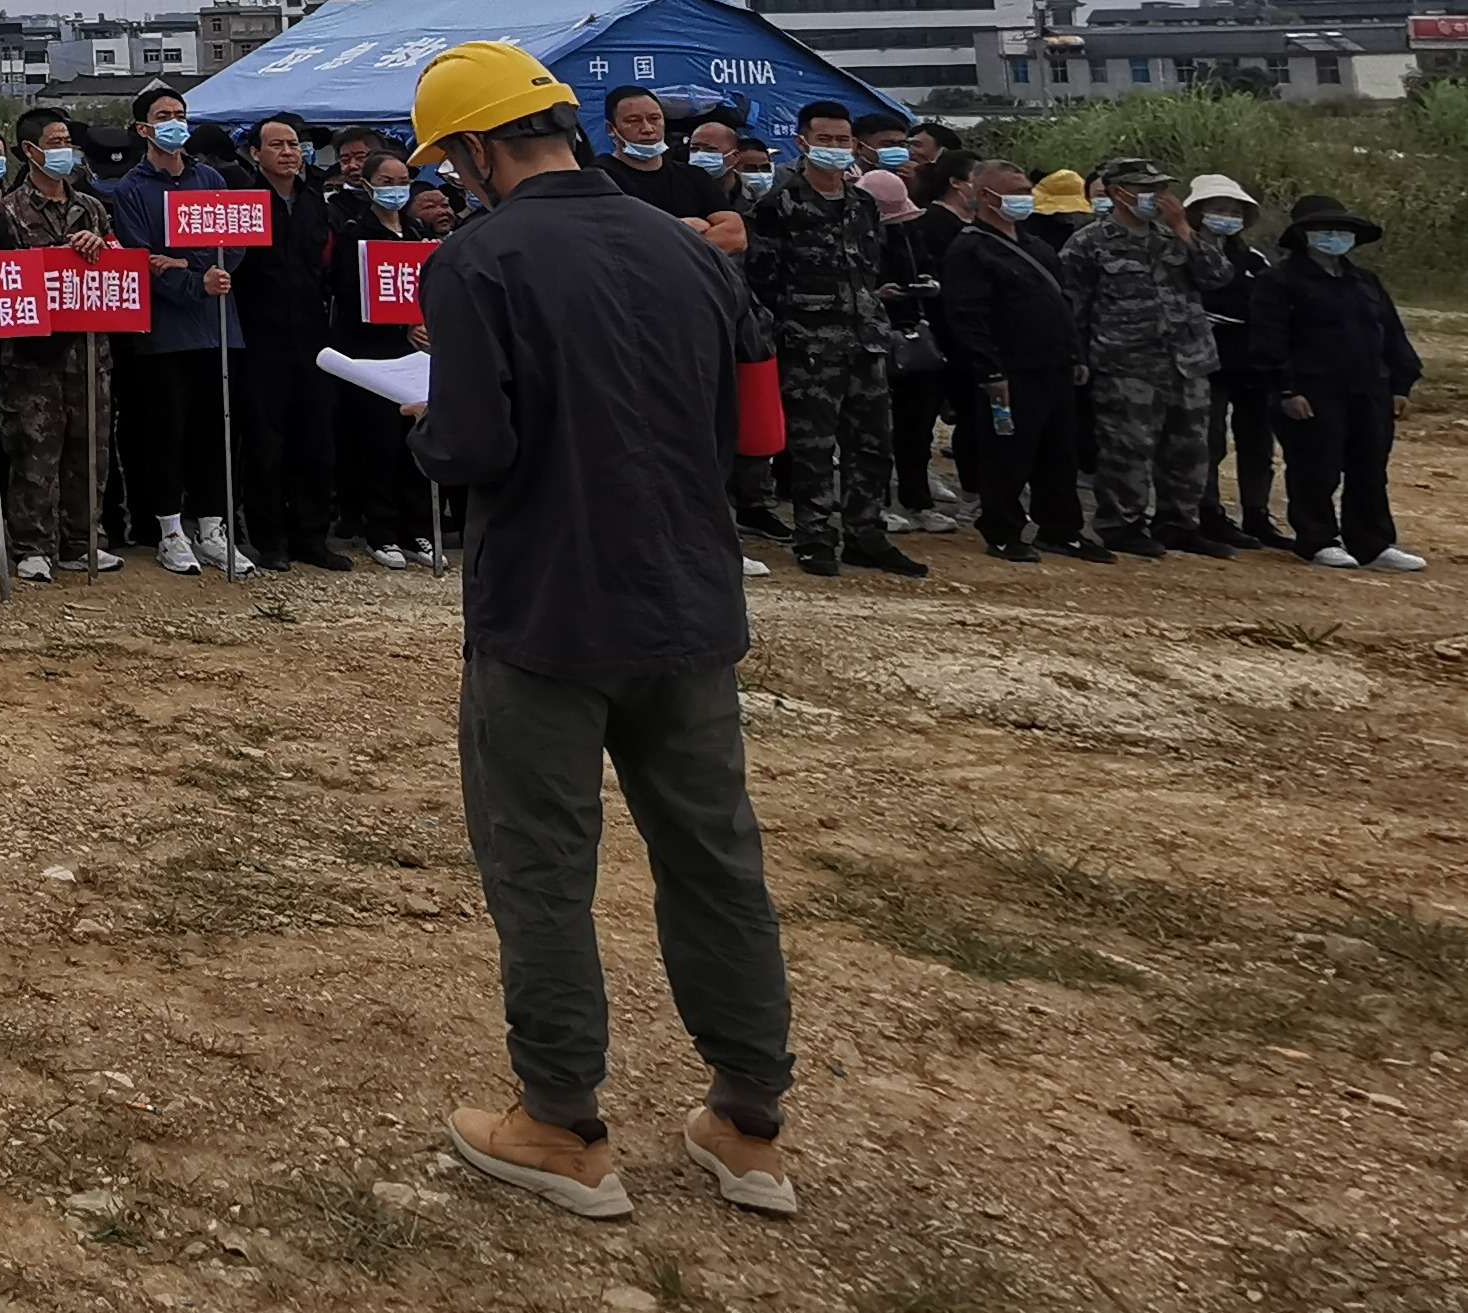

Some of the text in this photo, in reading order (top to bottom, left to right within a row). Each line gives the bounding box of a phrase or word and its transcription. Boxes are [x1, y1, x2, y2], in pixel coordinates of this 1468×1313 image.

[710, 58, 776, 85] CHINA
[177, 203, 265, 235] 灾害应急督察组
[377, 262, 422, 303] 宣传
